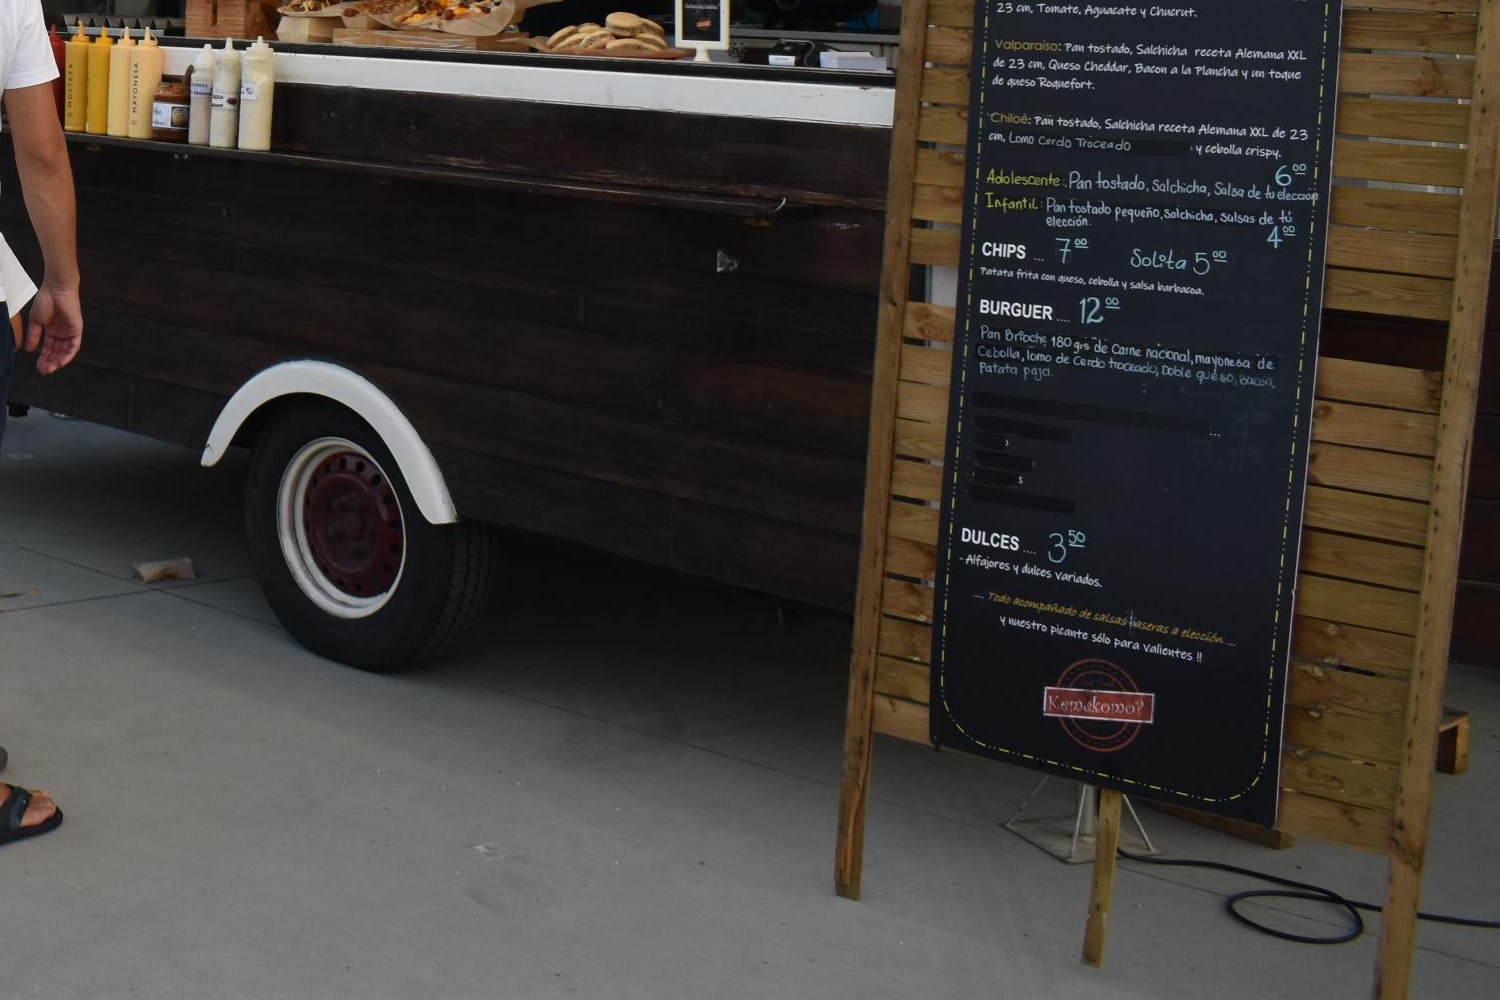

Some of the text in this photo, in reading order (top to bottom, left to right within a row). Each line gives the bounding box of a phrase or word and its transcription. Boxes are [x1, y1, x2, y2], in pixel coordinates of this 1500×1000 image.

[997, 3, 1197, 18] 23 cm, Tomate, Aguacate y Chucrut.
[1065, 43, 1084, 52] Pan
[1088, 43, 1133, 55] tostado,
[1136, 44, 1187, 56] Salchicha
[1195, 48, 1231, 57] receta
[1235, 48, 1283, 60] Alemana
[1287, 50, 1307, 60] XXL
[993, 57, 1301, 81] de 23 cm, Queso Cheddar, Bacon a la Plancha y un toque
[132, 62, 140, 115] MAYONESA
[992, 75, 1095, 90] de queso Roquefort.
[1034, 116, 1053, 125] Pan
[1057, 117, 1101, 129] tostado,
[1105, 119, 1155, 131] Salchicha
[1159, 123, 1195, 133] receta
[1198, 124, 1246, 136] Alemana
[1250, 127, 1268, 137] XXL
[1272, 127, 1285, 138] de
[1290, 129, 1308, 140] 23
[989, 132, 1005, 142] cm,
[1009, 132, 1034, 145] Lomo
[1196, 145, 1202, 155] y
[1205, 143, 1241, 155] cebolla
[1245, 147, 1281, 159] crispy.
[1069, 171, 1092, 189] Pan
[1095, 170, 1149, 192] tostado,
[1214, 182, 1244, 198] Salsa
[1248, 184, 1261, 199] de
[1264, 185, 1274, 199] tu
[1046, 197, 1066, 212] Pan
[1068, 200, 1111, 215] tostado
[1259, 211, 1273, 225] de
[982, 242, 1026, 259] CHIPS
[981, 267, 1013, 278] Patata
[1017, 269, 1038, 280] frita
[1058, 275, 1086, 285] queso,
[1088, 277, 1119, 288] cebolla
[1122, 282, 1127, 290] y
[1130, 280, 1154, 291] salsa
[1158, 282, 1204, 296] barbacoa.
[980, 299, 1052, 320] BURGUER
[981, 325, 1000, 340] Pan
[1052, 336, 1072, 348] 180
[1094, 340, 1108, 354] de
[1258, 358, 1274, 370] de
[1027, 350, 1052, 362] lomo
[1056, 353, 1069, 364] de
[980, 362, 1017, 376] Patata
[961, 528, 1019, 551] DULCES
[965, 554, 1010, 570] Alfajores
[1013, 564, 1018, 574] y
[1022, 563, 1051, 578] dulces
[1013, 596, 1076, 617] acompañado
[1079, 609, 1091, 619] de
[1093, 611, 1126, 625] salsas
[1172, 626, 1178, 635] a
[1000, 616, 1005, 626] y
[1009, 617, 1047, 632] nuestro
[1050, 625, 1088, 640] picante
[1092, 633, 1110, 645] sólo
[1114, 637, 1139, 650] para
